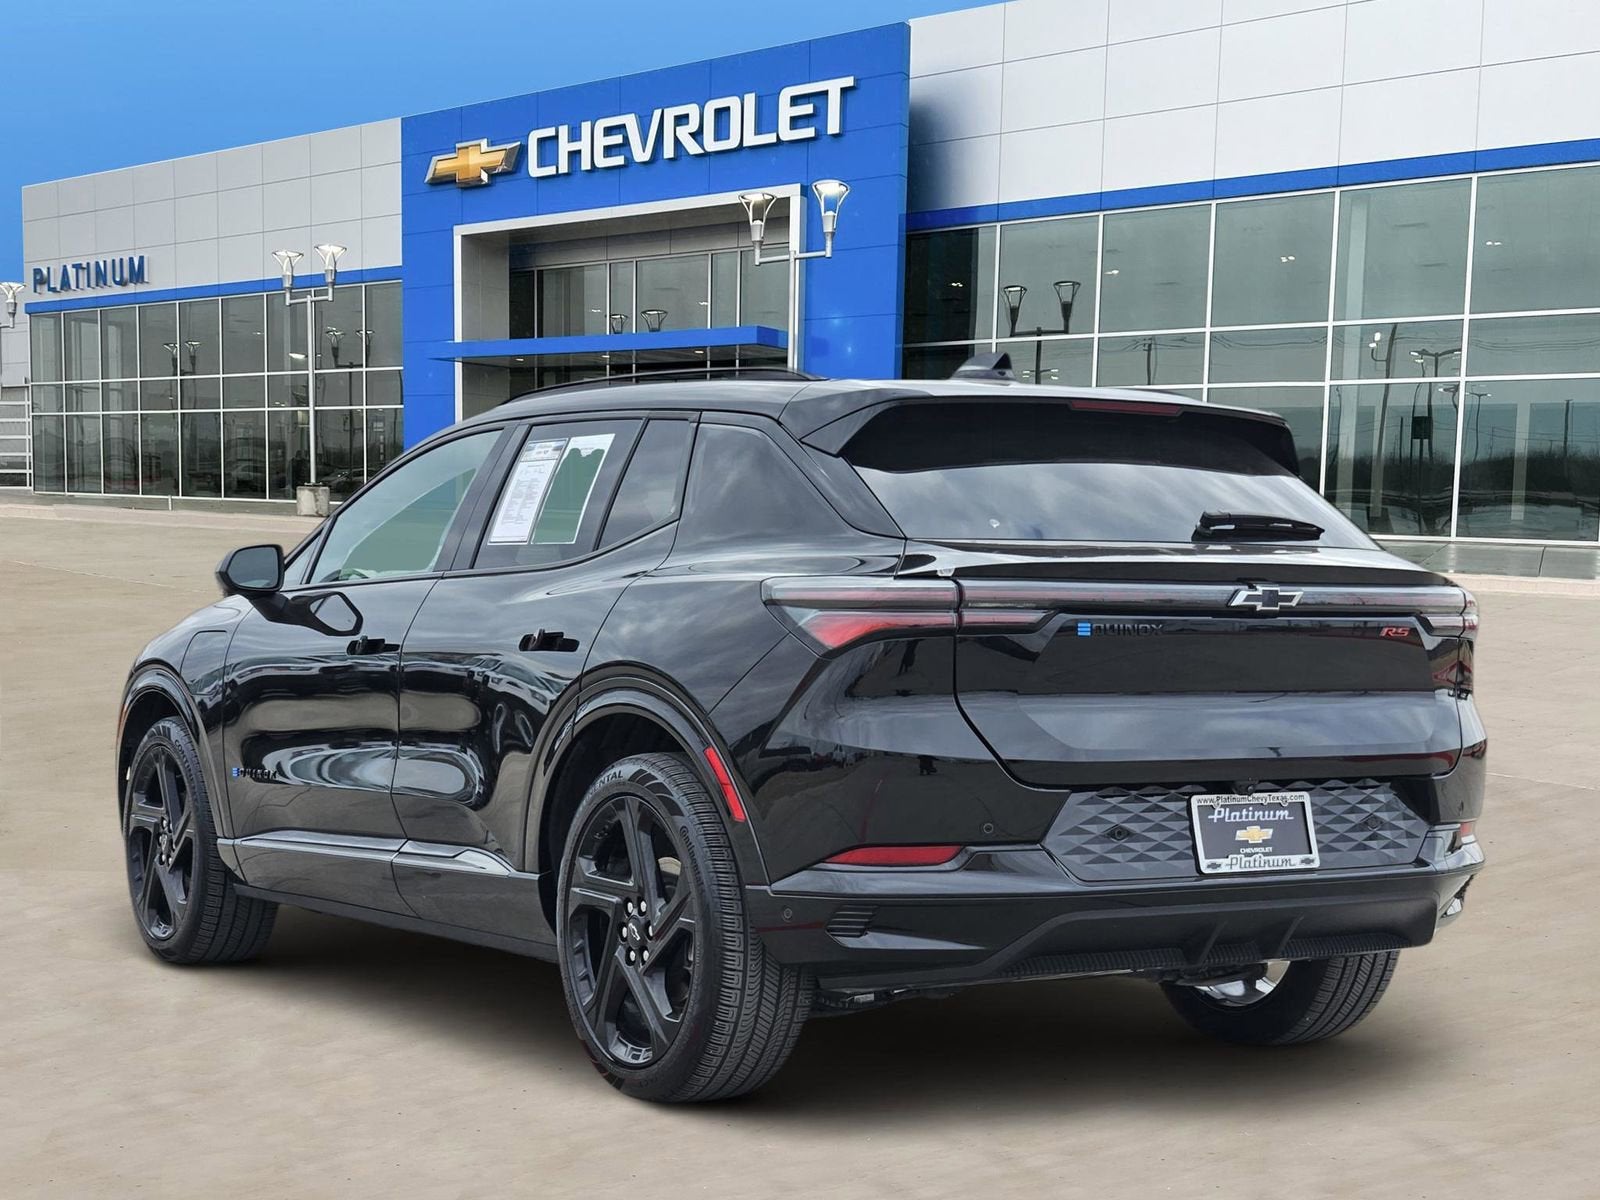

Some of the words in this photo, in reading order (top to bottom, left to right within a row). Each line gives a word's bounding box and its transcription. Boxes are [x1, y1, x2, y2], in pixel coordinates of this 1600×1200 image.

[527, 75, 856, 178] CHEVROLET
[33, 255, 147, 293] PLATINUM
[1379, 627, 1410, 637] RS
[1208, 807, 1295, 822] Platinum
[1240, 846, 1273, 854] CHEVROLET
[1226, 855, 1297, 869] Platinum
